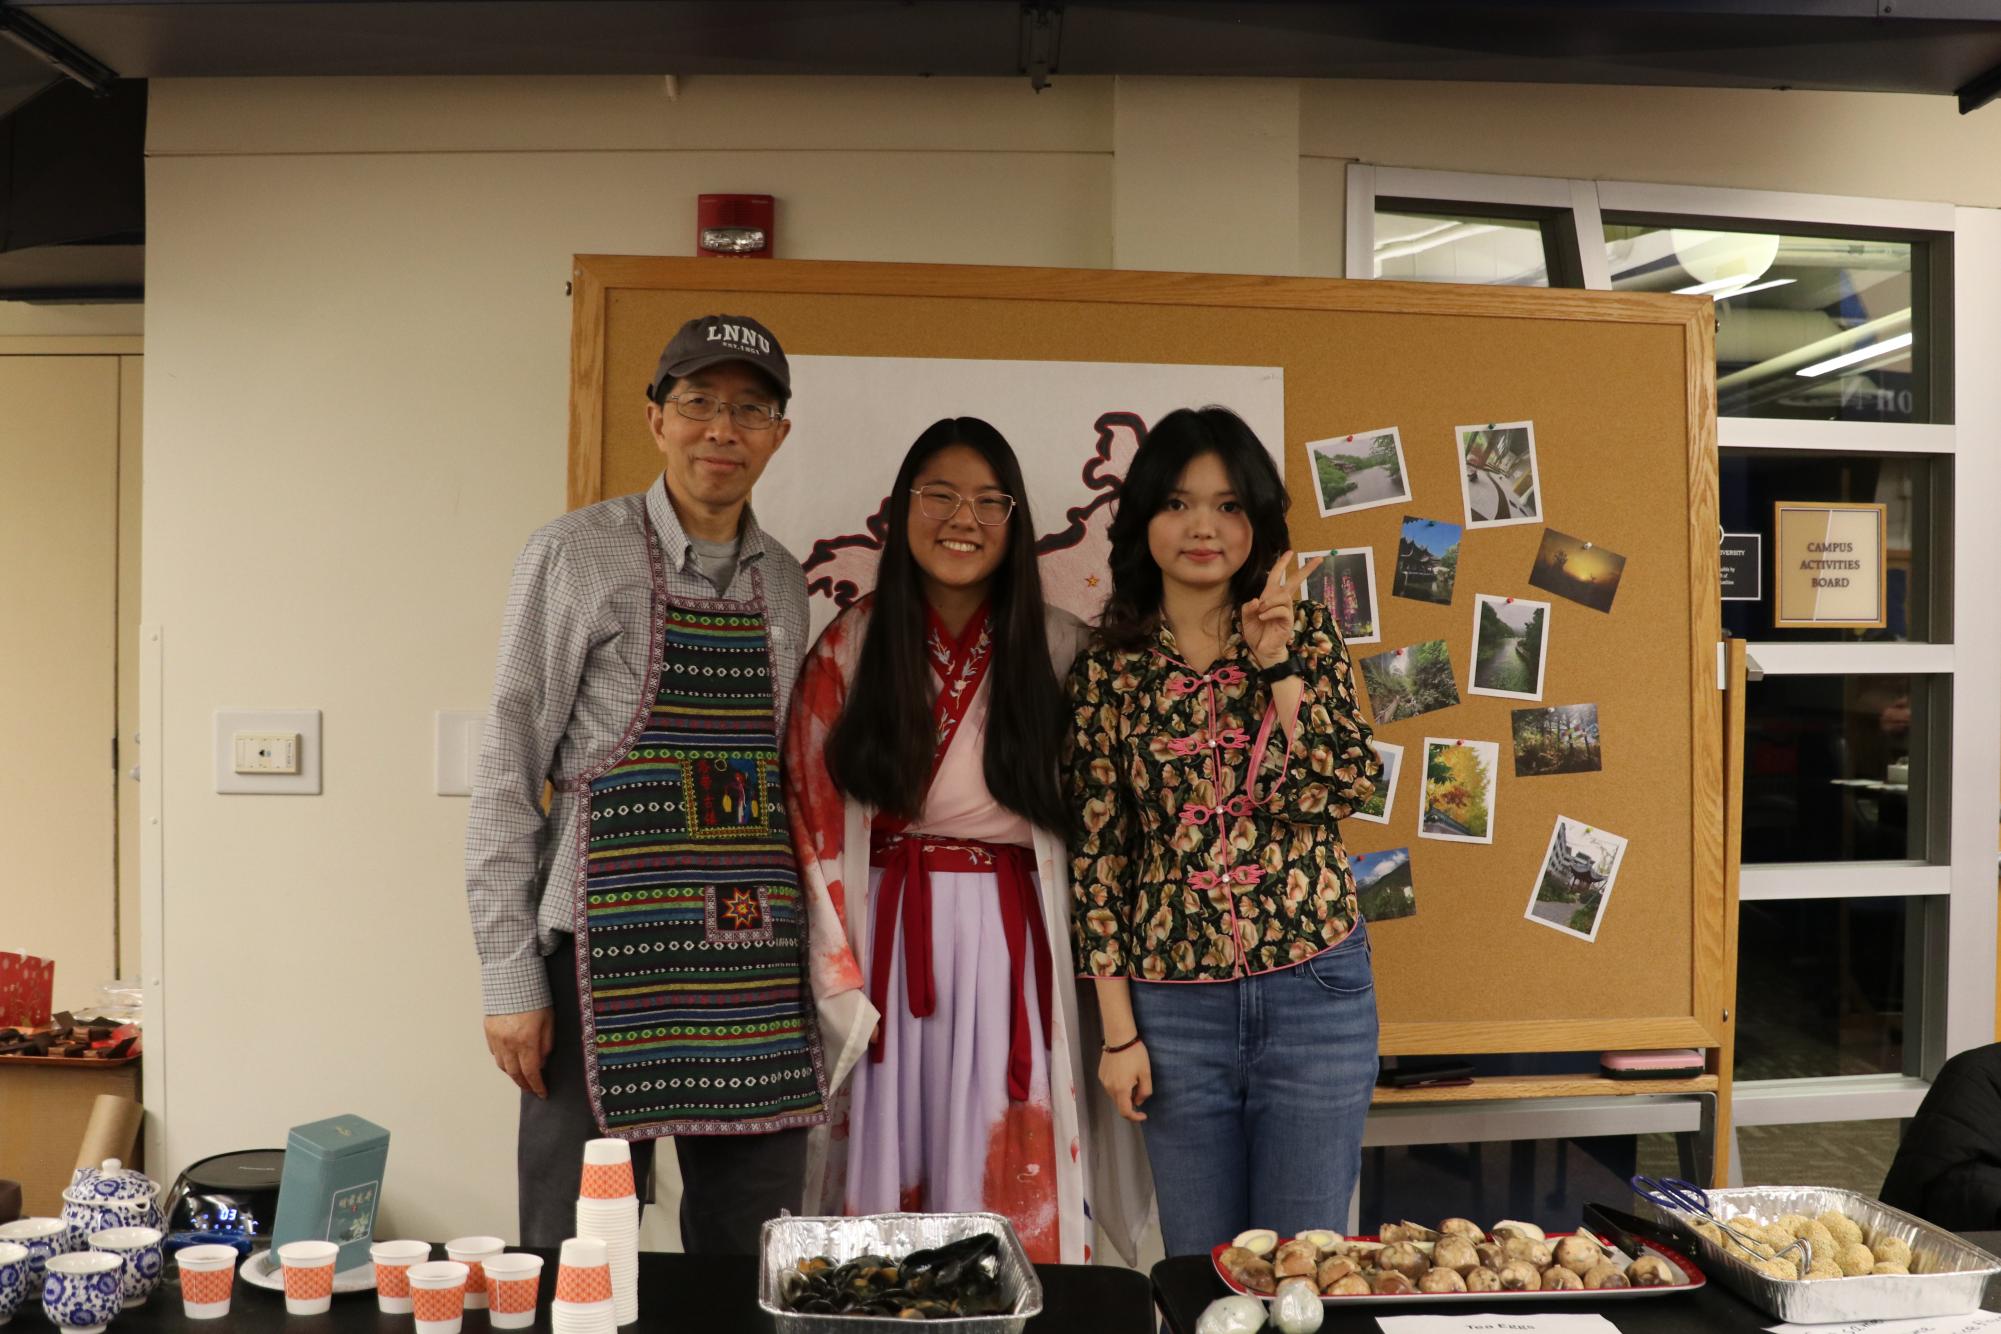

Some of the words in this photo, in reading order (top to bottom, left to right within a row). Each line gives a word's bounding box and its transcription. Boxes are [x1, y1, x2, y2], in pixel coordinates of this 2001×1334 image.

[706, 324, 770, 353] LNNU
[1807, 542, 1853, 552] CAMPUS
[1720, 549, 1746, 557] IVERSITY
[1799, 559, 1860, 570] ACTIVITIES
[1811, 577, 1850, 588] BOARD
